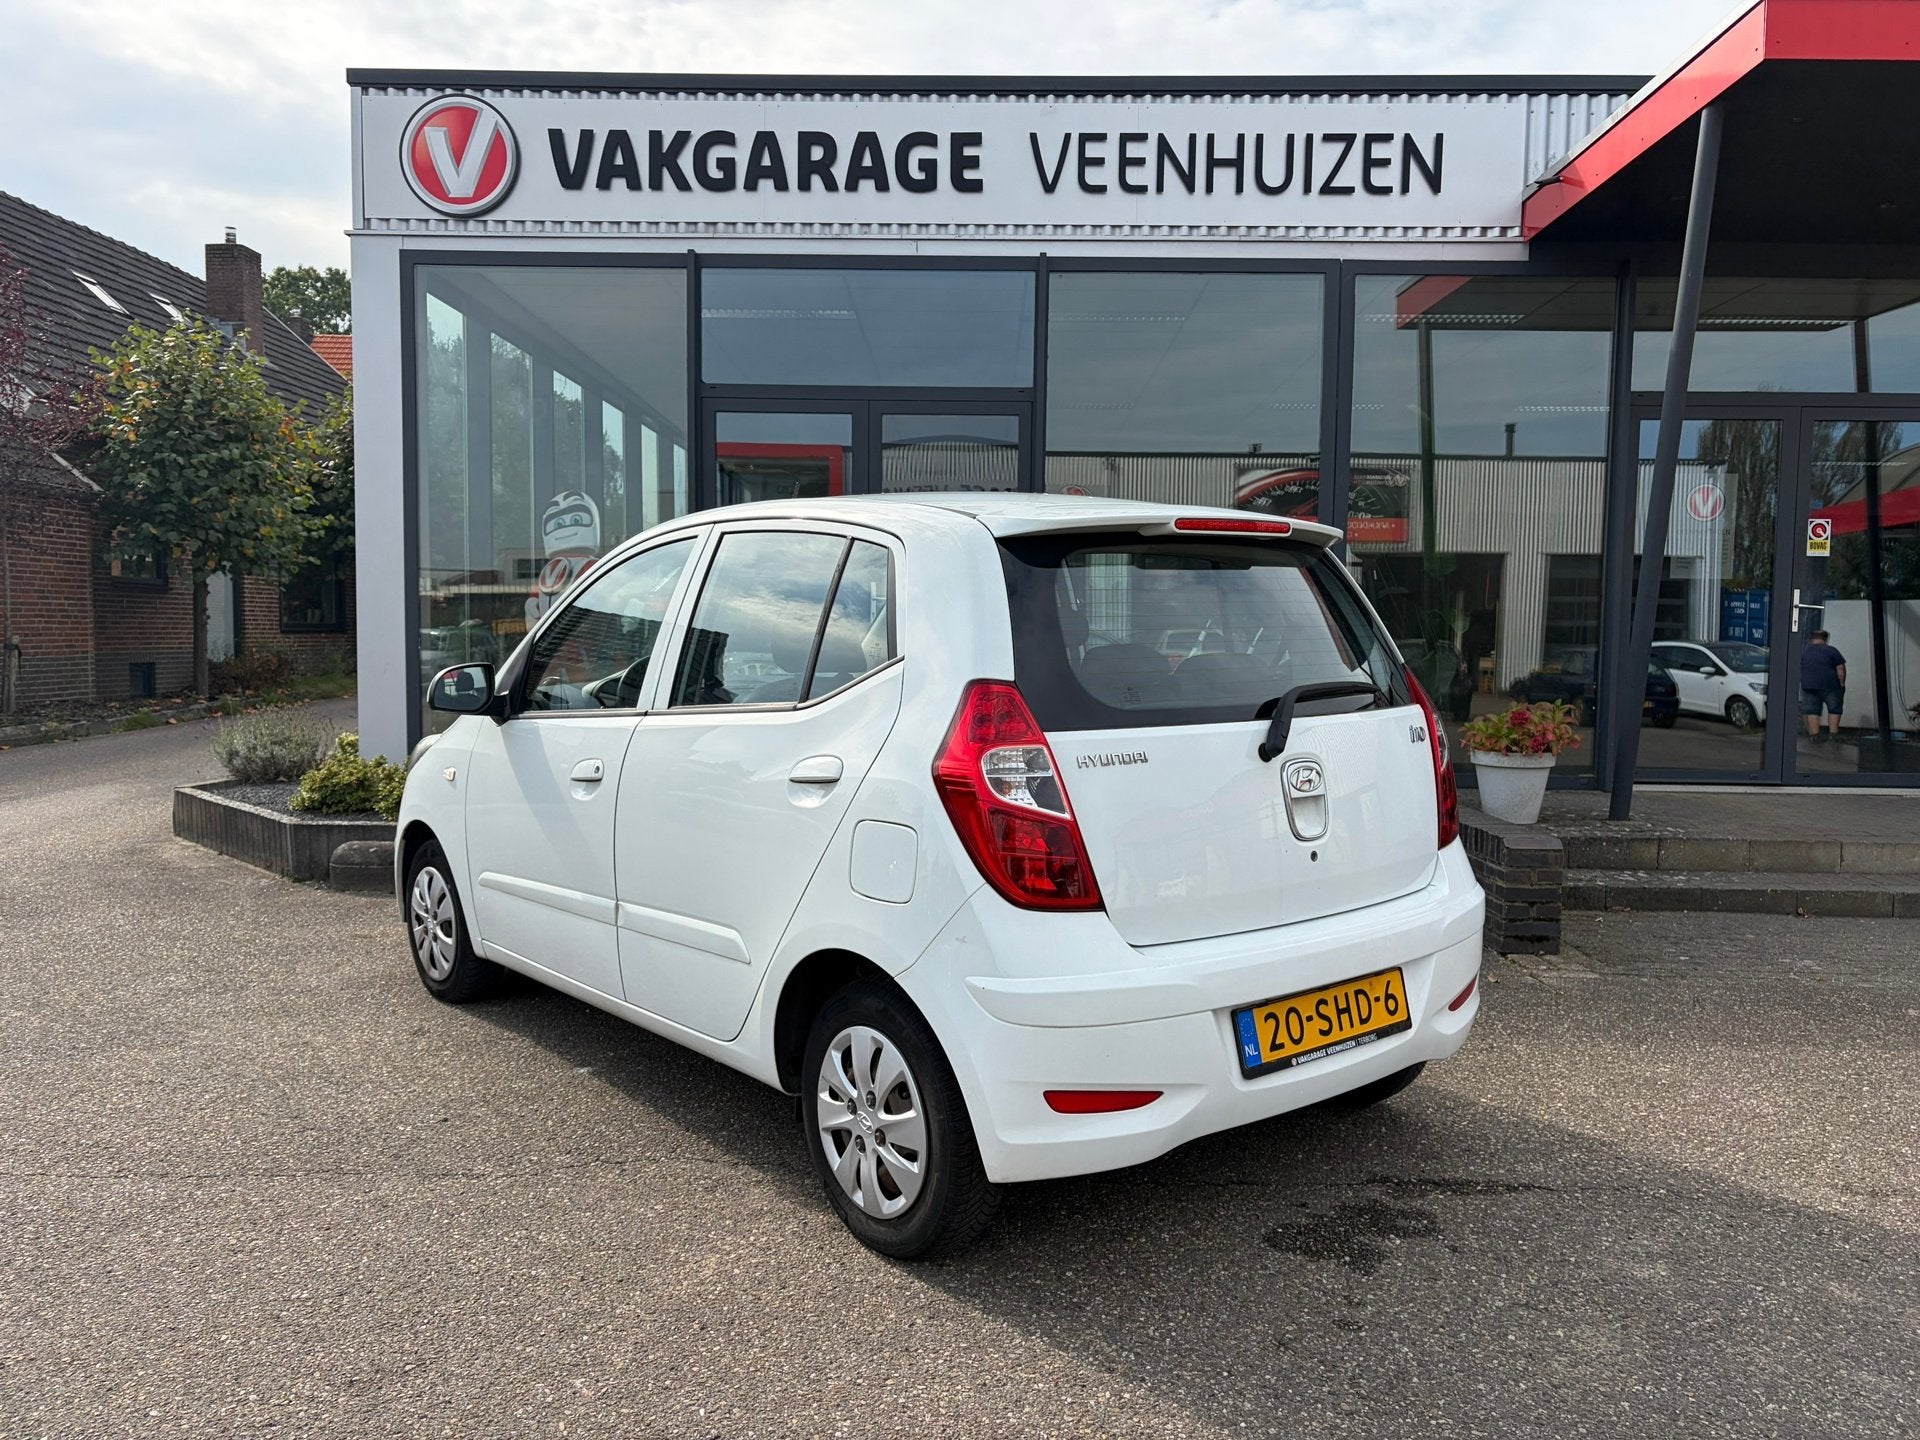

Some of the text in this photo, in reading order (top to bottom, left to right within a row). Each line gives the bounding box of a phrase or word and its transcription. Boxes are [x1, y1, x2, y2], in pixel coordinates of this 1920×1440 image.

[548, 128, 1444, 195] VAKGARAGE VEENHUIZEN
[1810, 541, 1827, 550] BOVAG
[1410, 725, 1425, 743] i10
[1077, 750, 1148, 768] HYUNDAI
[1264, 980, 1399, 1053] 20-SHD-6
[1245, 1045, 1258, 1057] NL
[1297, 1050, 1327, 1064] VAKGARAGE
[1327, 1040, 1356, 1055] VEENHUIZEN
[1358, 1033, 1377, 1046] TERBORG
